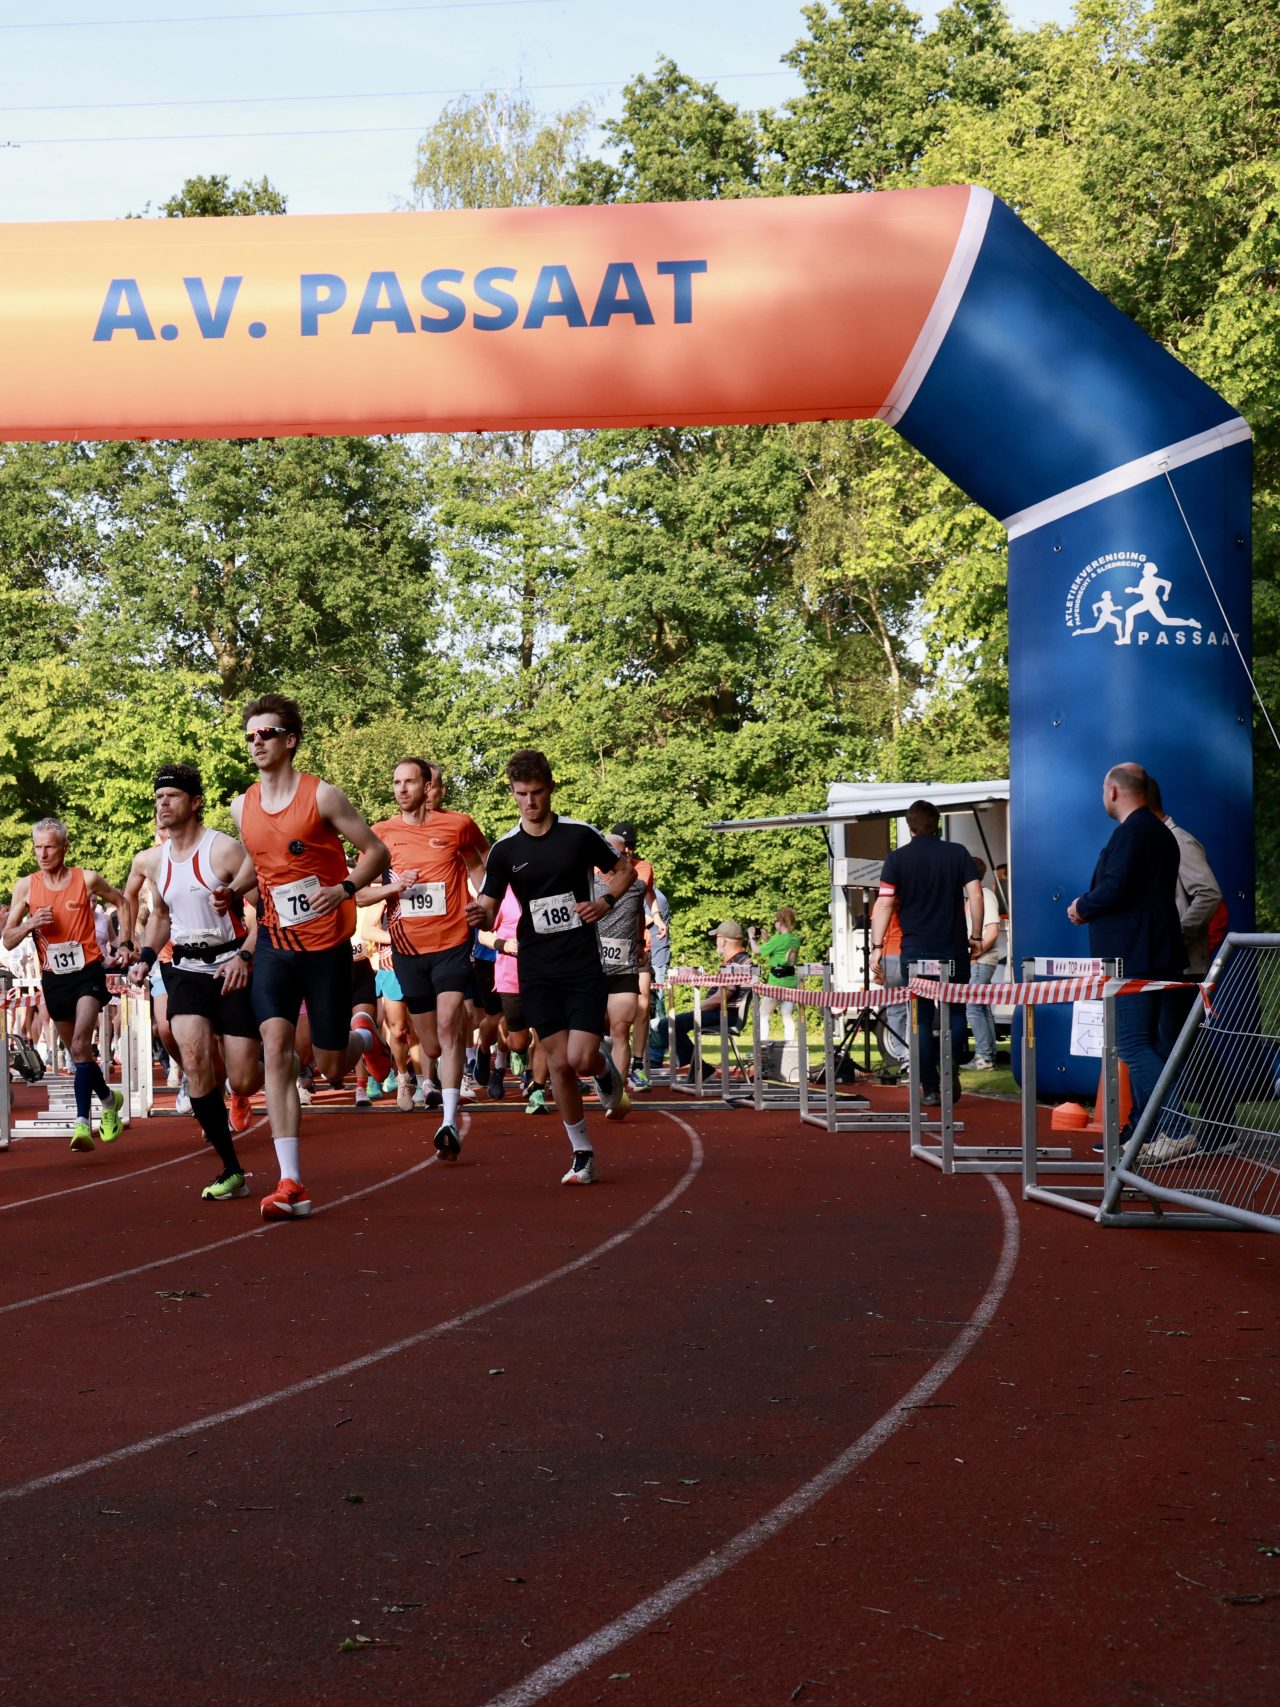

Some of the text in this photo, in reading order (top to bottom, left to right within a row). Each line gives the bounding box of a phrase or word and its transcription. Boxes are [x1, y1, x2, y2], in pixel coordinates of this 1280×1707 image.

[92, 260, 708, 342] A.V. PASSAAT
[1066, 551, 1147, 627] ATLETIEKVERENIGING
[1073, 578, 1091, 626] PAPENDRECHT
[1097, 561, 1141, 575] SLIEDRECHT
[1138, 631, 1239, 645] PASSAAT
[287, 893, 310, 916] 78
[409, 894, 433, 910] 199
[543, 906, 571, 926] 188
[53, 951, 76, 968] 131
[603, 946, 621, 960] 302
